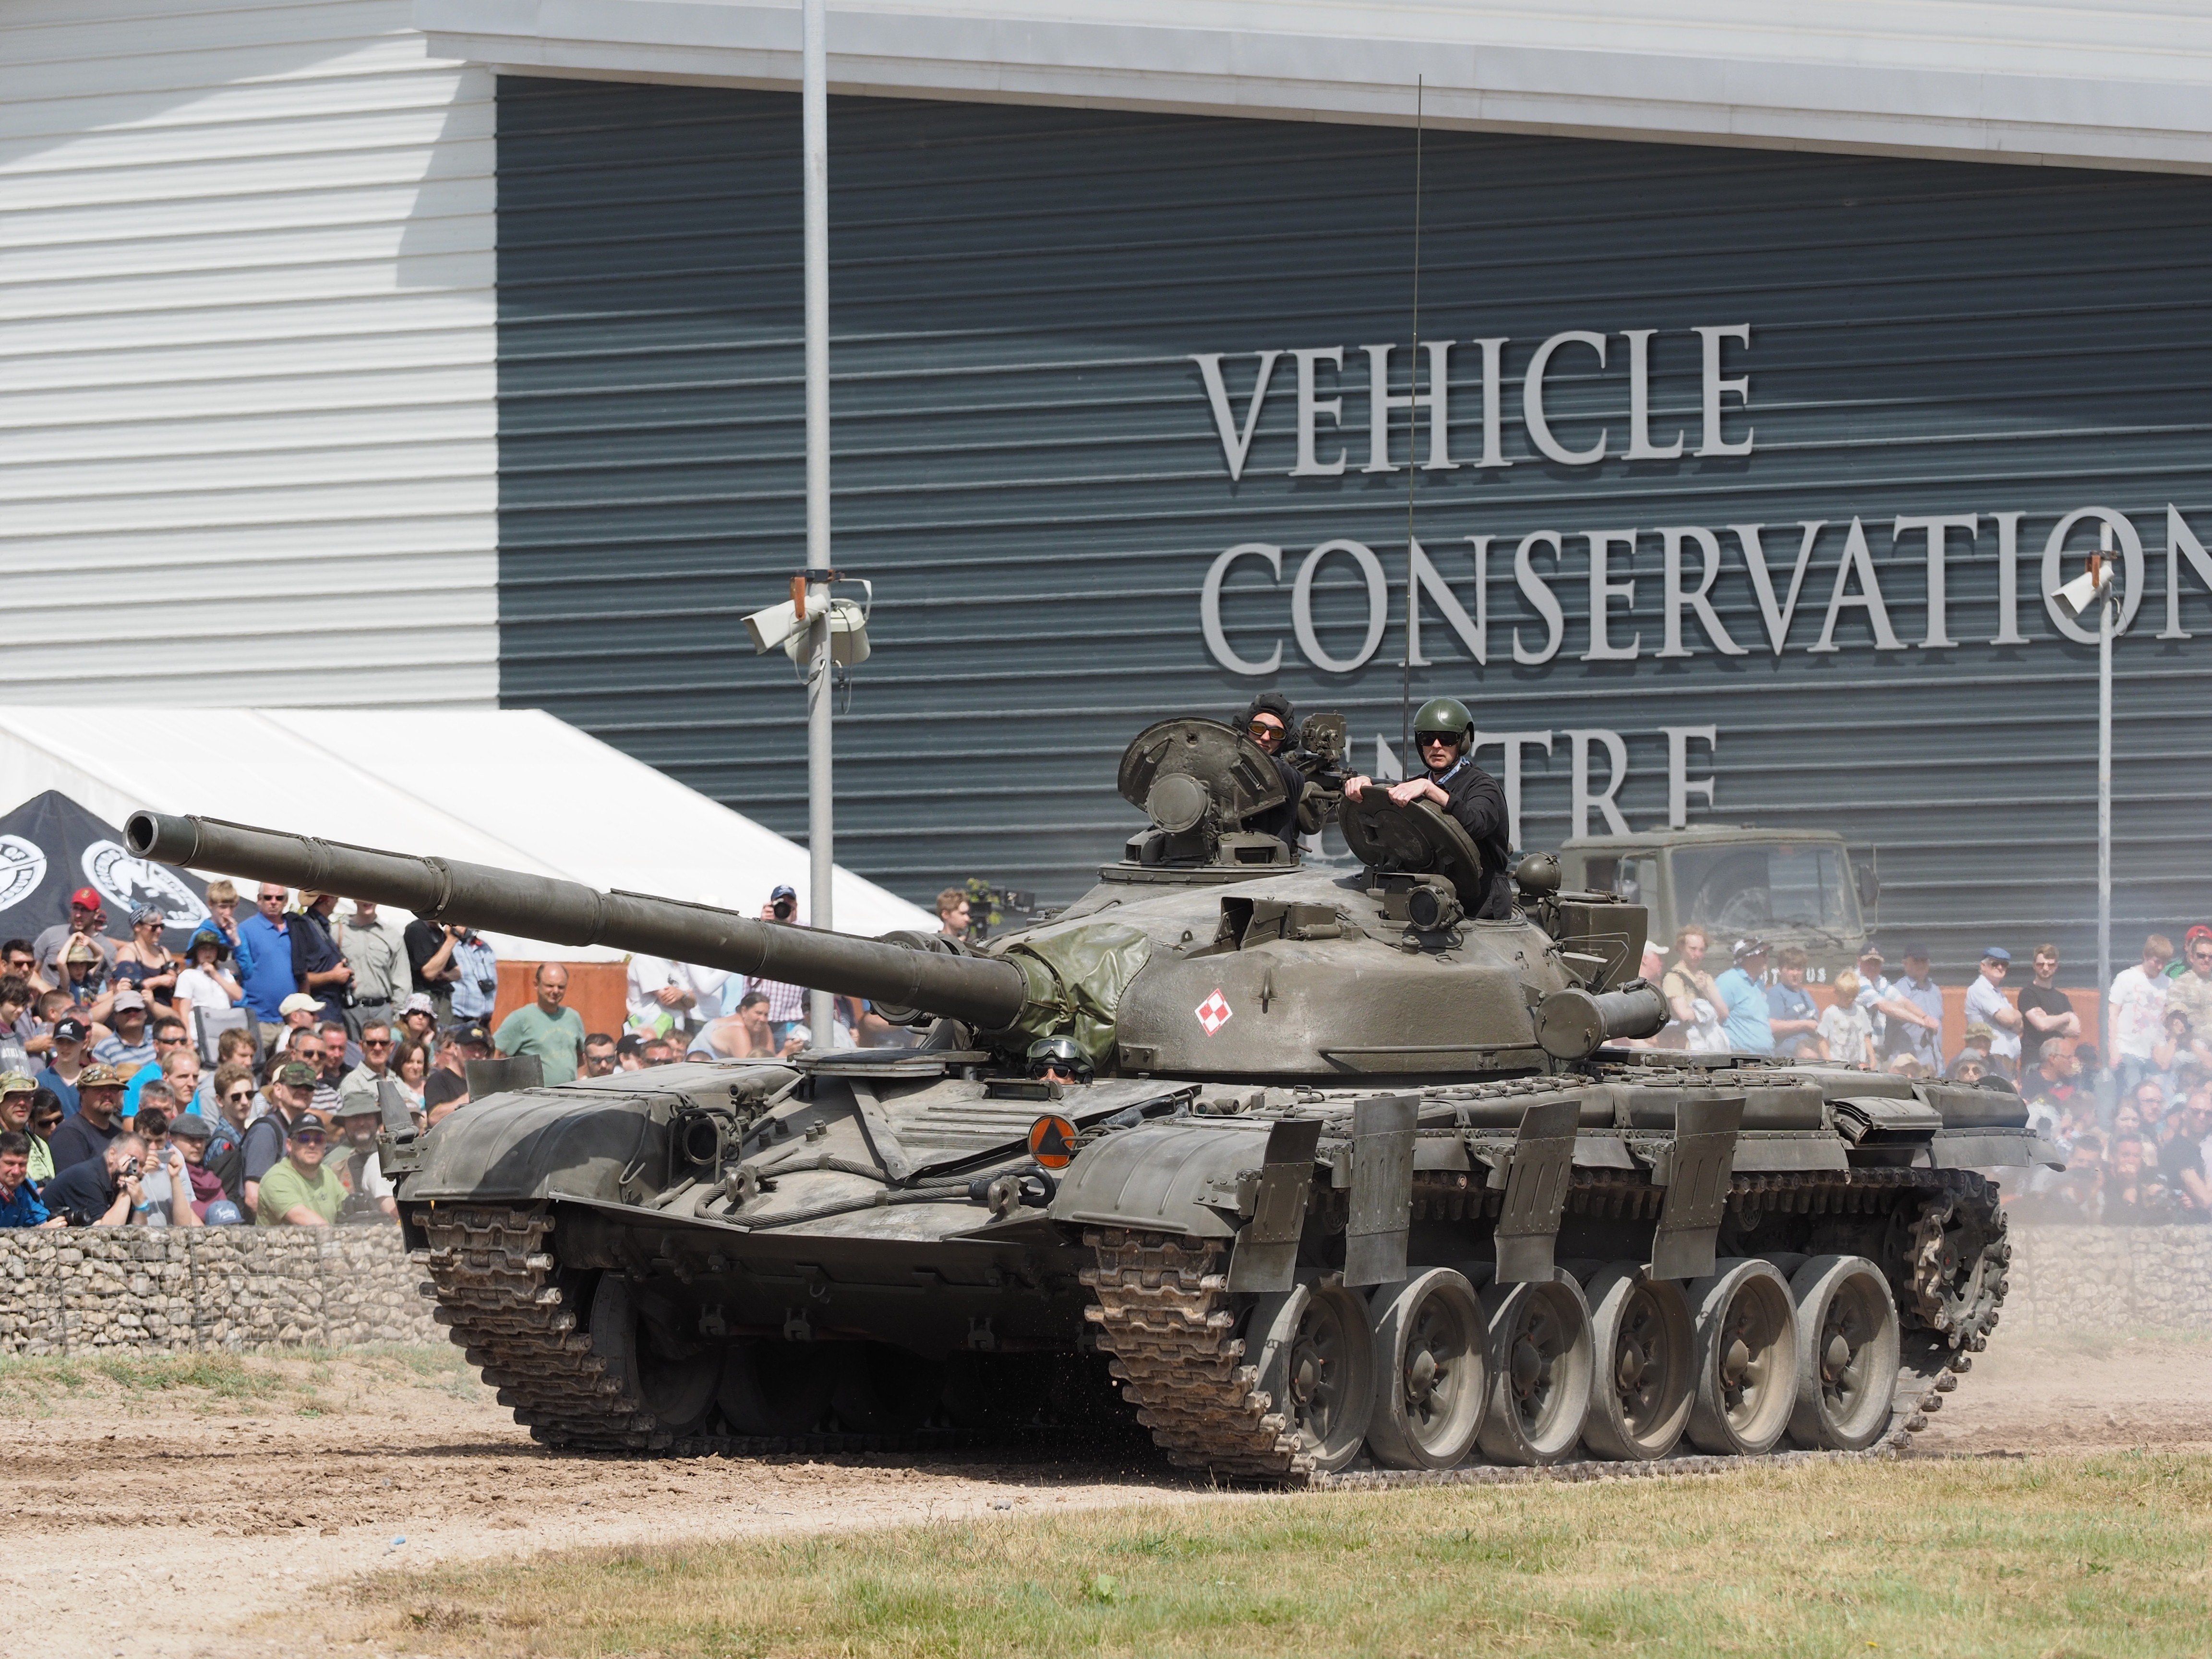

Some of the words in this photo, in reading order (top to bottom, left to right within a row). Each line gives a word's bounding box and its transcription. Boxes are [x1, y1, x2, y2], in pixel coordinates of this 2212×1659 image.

[1188, 323, 1754, 481] VEHICLE
[1201, 502, 2212, 675] CONSERVATION
[1303, 724, 1717, 861] TRE
